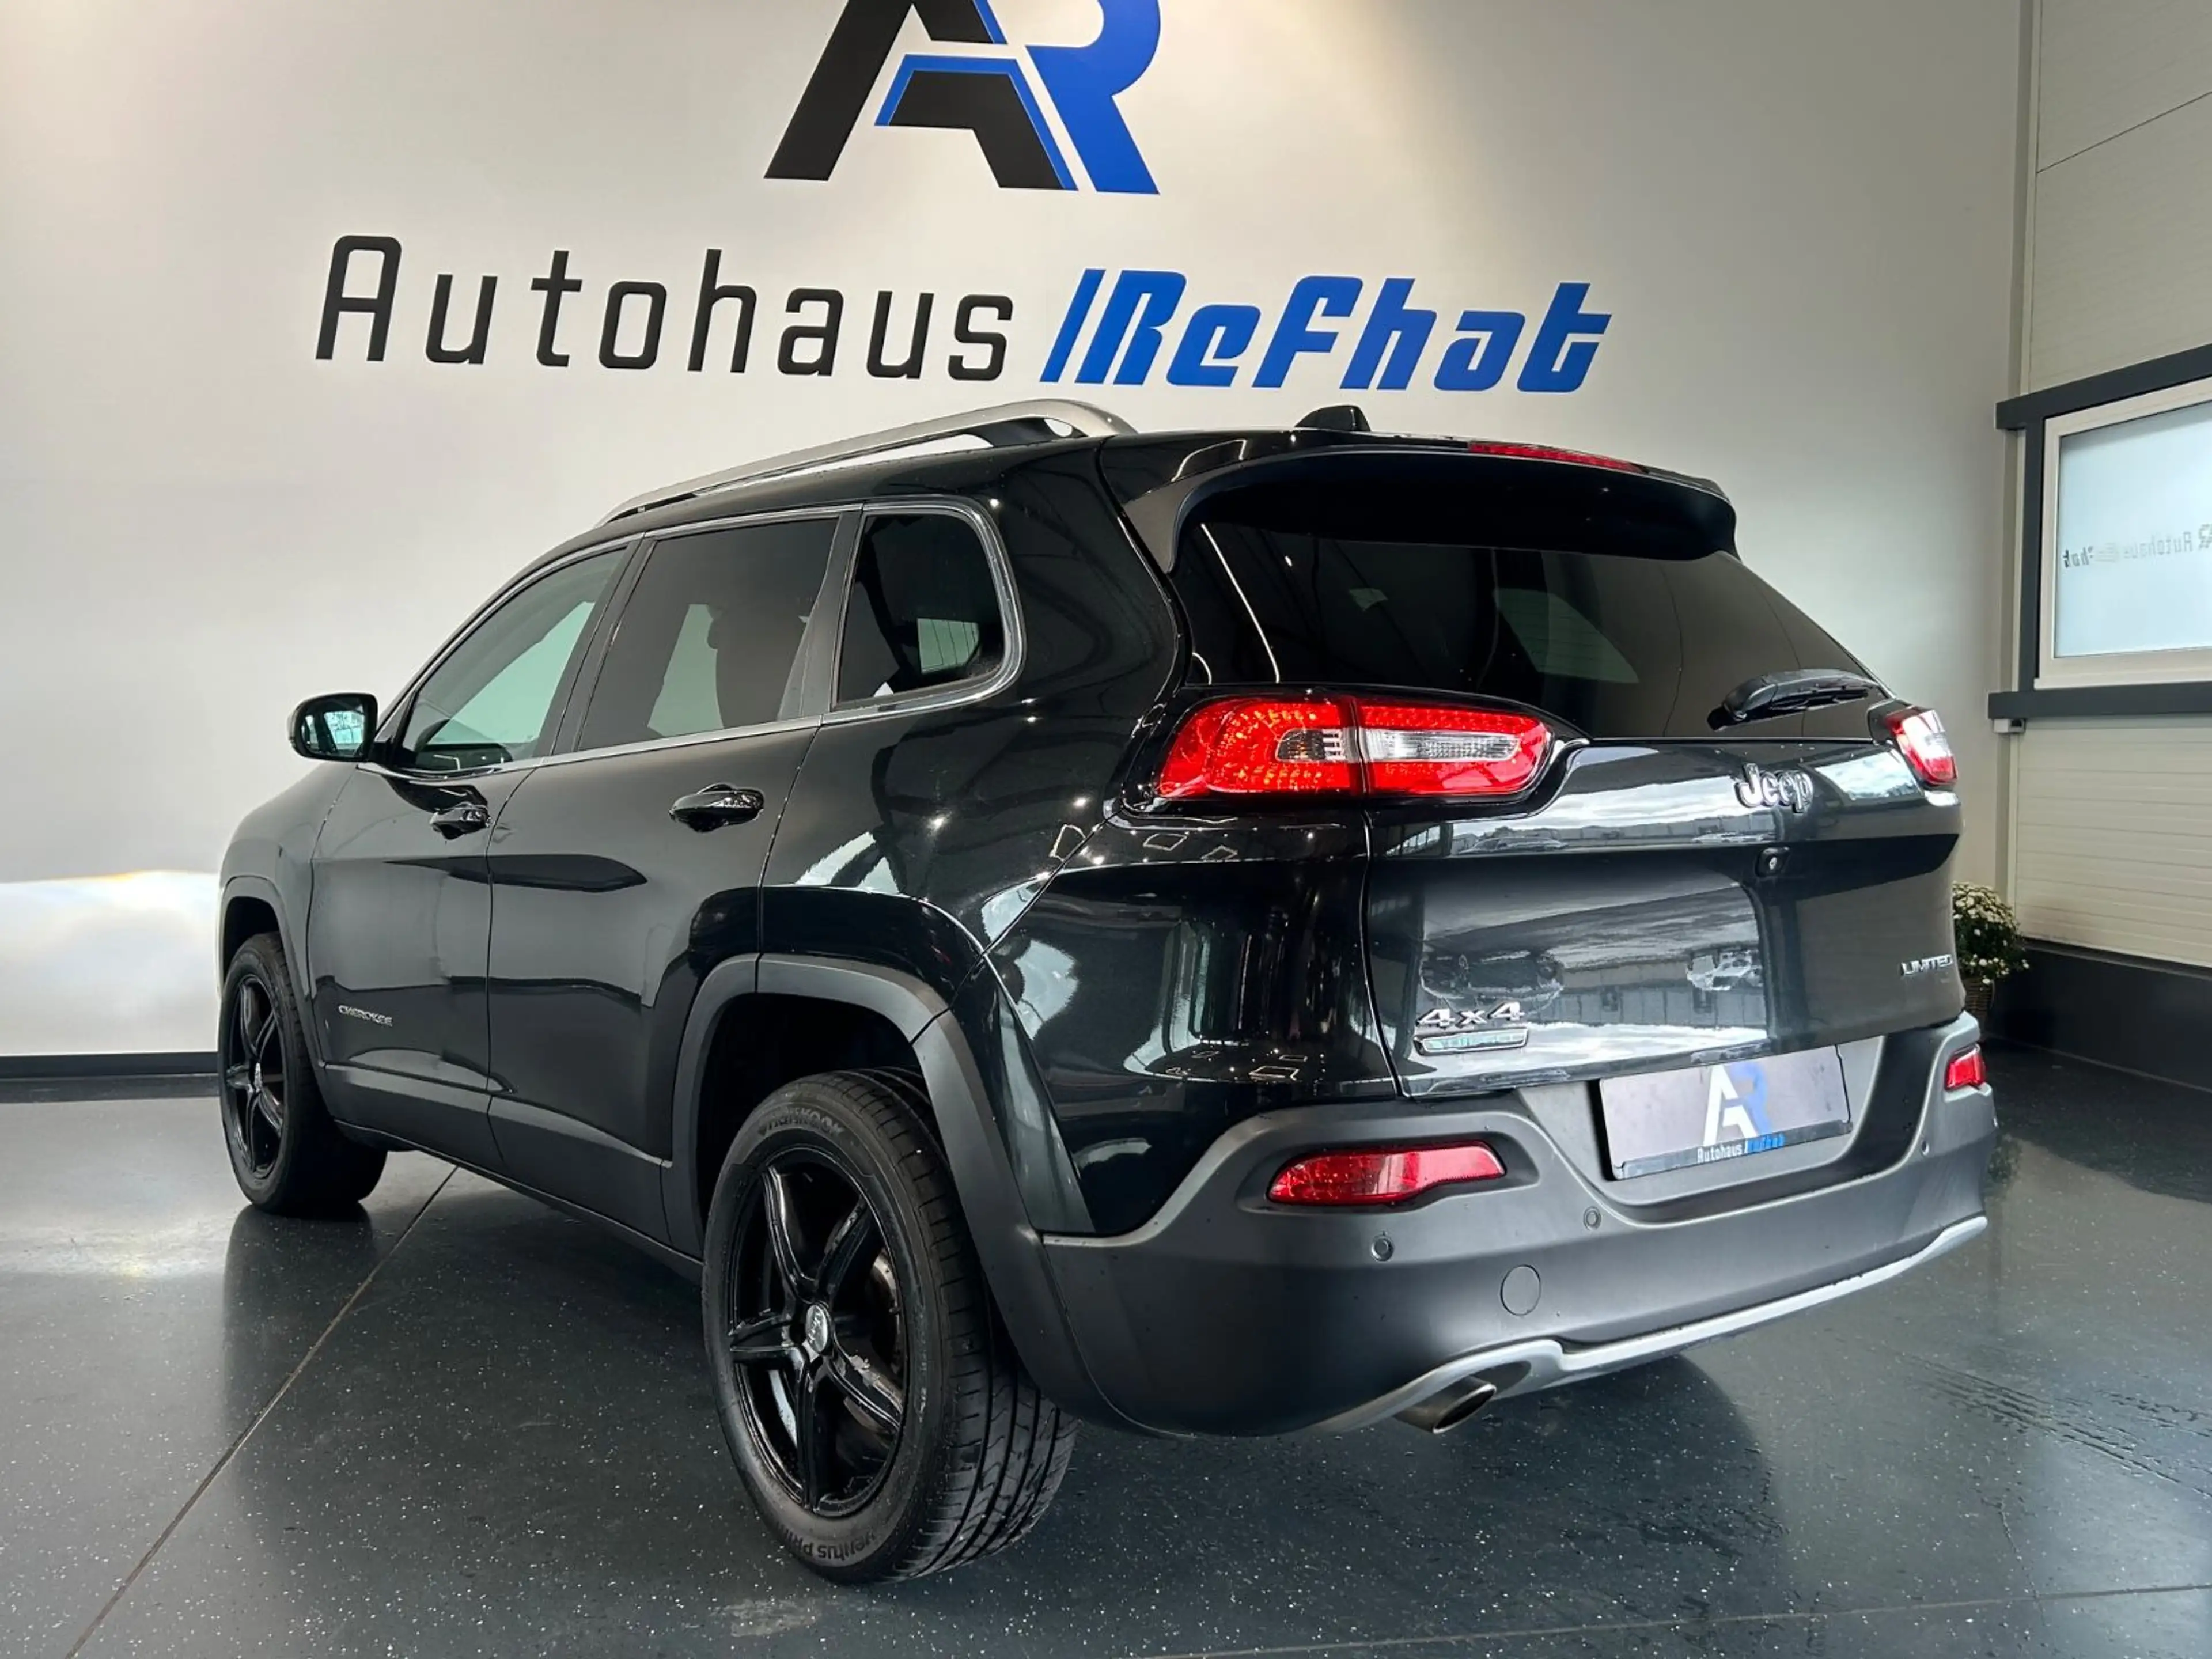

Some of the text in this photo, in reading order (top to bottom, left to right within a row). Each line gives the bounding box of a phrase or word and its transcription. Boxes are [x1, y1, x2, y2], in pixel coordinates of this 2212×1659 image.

[316, 235, 1013, 380] Autohaus
[1734, 763, 1813, 813] Jeep
[1415, 1002, 1525, 1028] 4x4
[1697, 1142, 1743, 1164] Autohaus
